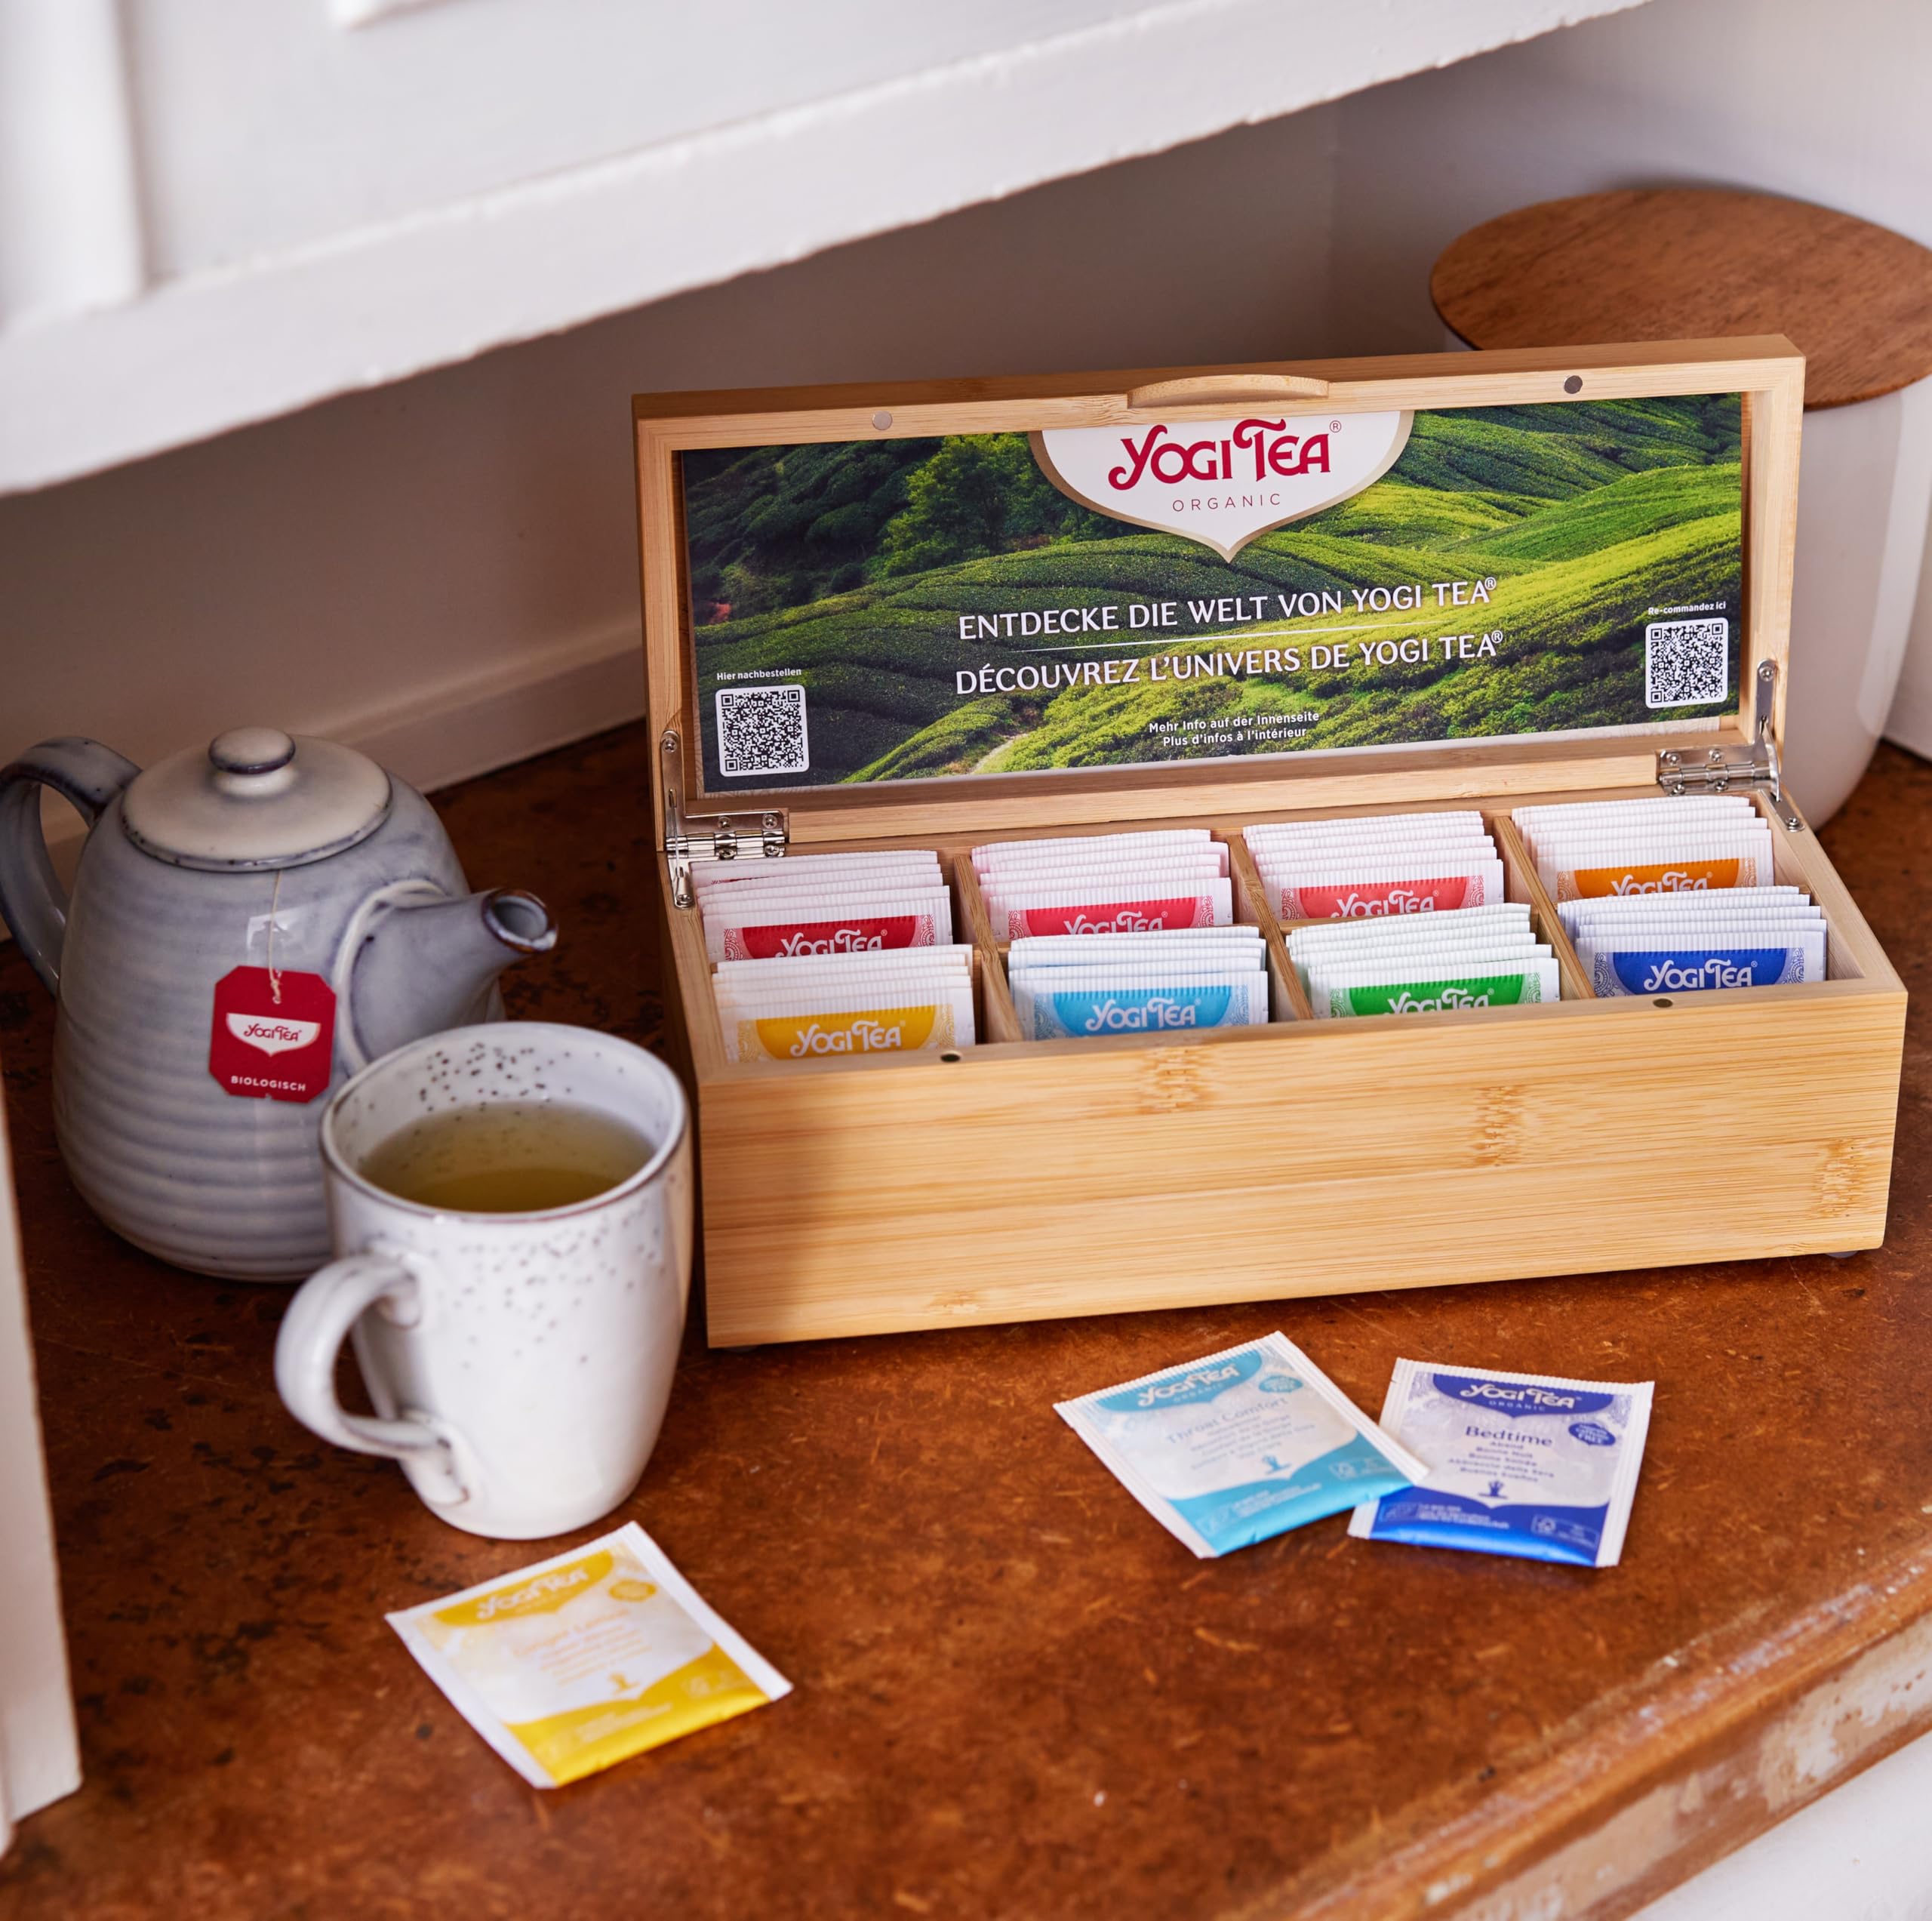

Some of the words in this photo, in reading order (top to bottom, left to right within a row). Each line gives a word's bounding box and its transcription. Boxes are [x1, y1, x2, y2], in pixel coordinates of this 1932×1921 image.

[1108, 423, 1232, 490] YOGI
[1172, 493, 1281, 512] ORGANIC
[959, 605, 1118, 640] ENTDECKE
[1129, 602, 1177, 629] DIE
[1187, 596, 1268, 623] WELT
[1278, 590, 1342, 617] VON
[1352, 585, 1421, 612] YOGI
[1647, 603, 1715, 615] Re-commandez
[1715, 601, 1726, 610] ici
[716, 672, 736, 681] Hier
[737, 668, 802, 679] nachbestellen
[956, 658, 1140, 694] DÉCOUVREZ
[1311, 644, 1349, 670] DE
[1358, 639, 1428, 666] YOGI
[1149, 722, 1179, 733] Mehr
[1183, 719, 1207, 731] Info
[1210, 717, 1229, 728] auf
[1233, 716, 1254, 728] der
[1257, 711, 1320, 725] Innenseite
[1163, 735, 1188, 747] Plus
[1236, 730, 1244, 741] à
[1330, 892, 1389, 919] YOGI
[774, 932, 835, 958] YOGI
[1643, 959, 1705, 991] YOGI
[1084, 998, 1148, 1031] YOGI
[243, 1024, 275, 1038] YOGI
[790, 1023, 853, 1057] YOGI
[231, 1075, 306, 1091] BIOLOGISCH
[1460, 1384, 1524, 1402] YOGI
[1465, 1425, 1552, 1447] Bedtime
